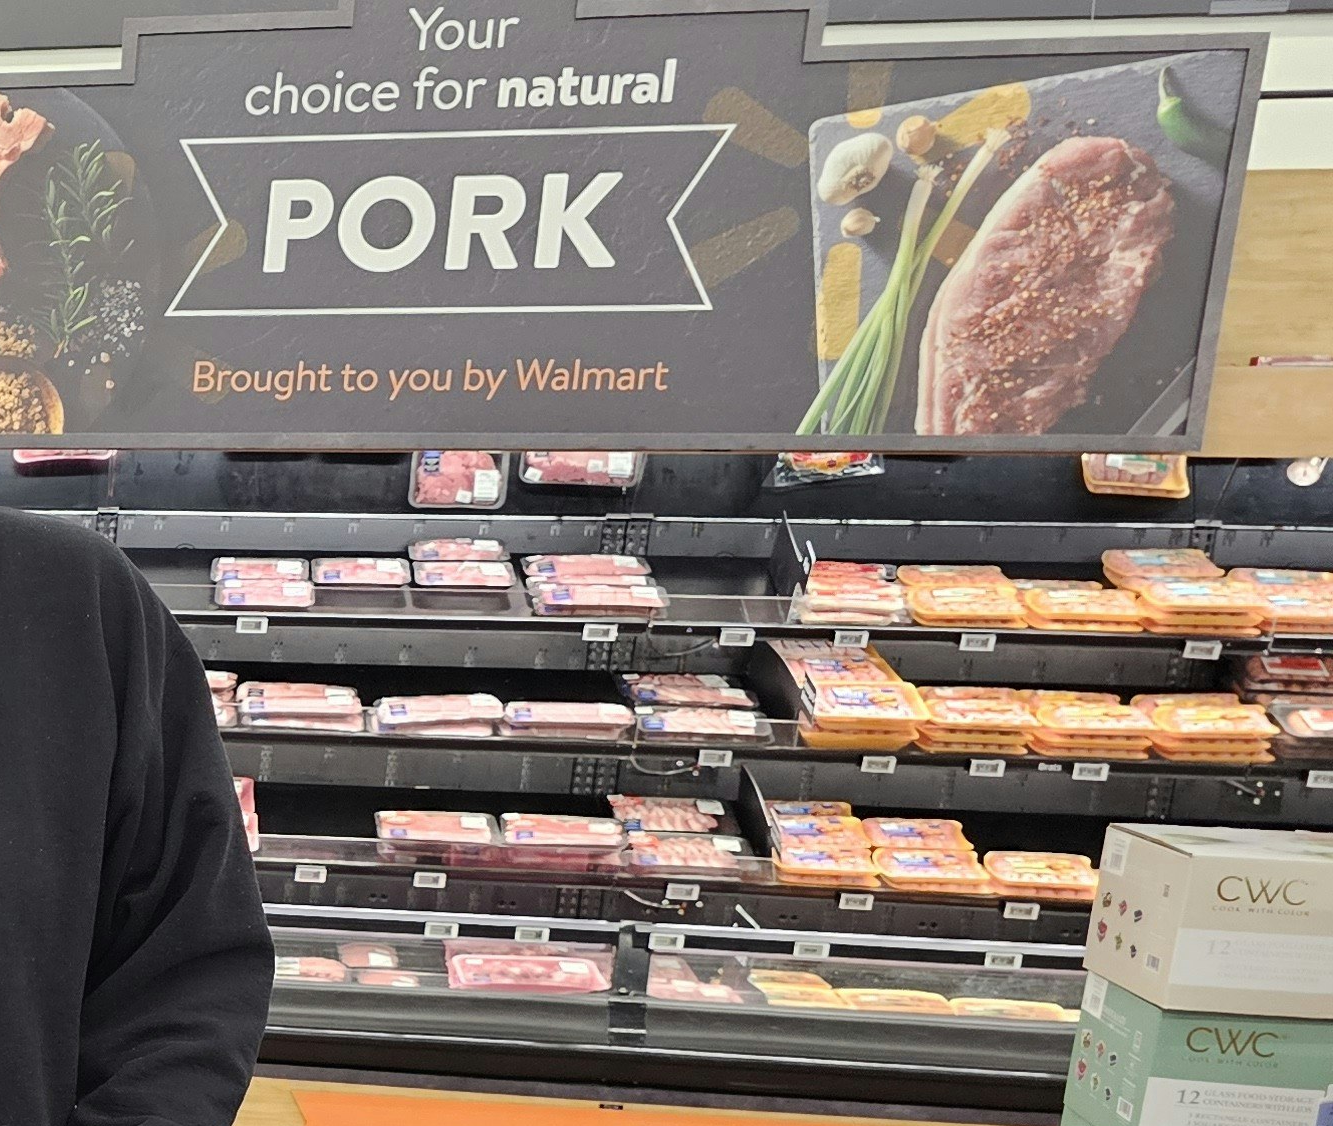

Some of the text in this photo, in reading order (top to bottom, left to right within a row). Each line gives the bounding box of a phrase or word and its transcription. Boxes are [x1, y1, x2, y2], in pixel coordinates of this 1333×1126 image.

[409, 7, 520, 54] Your
[244, 58, 678, 116] choice for natural
[262, 171, 624, 274] PORK
[191, 357, 669, 406] Brought to you by Walmart
[1216, 875, 1307, 906] CWC
[1185, 1026, 1280, 1058] CWC
[1176, 1089, 1201, 1105] 12
